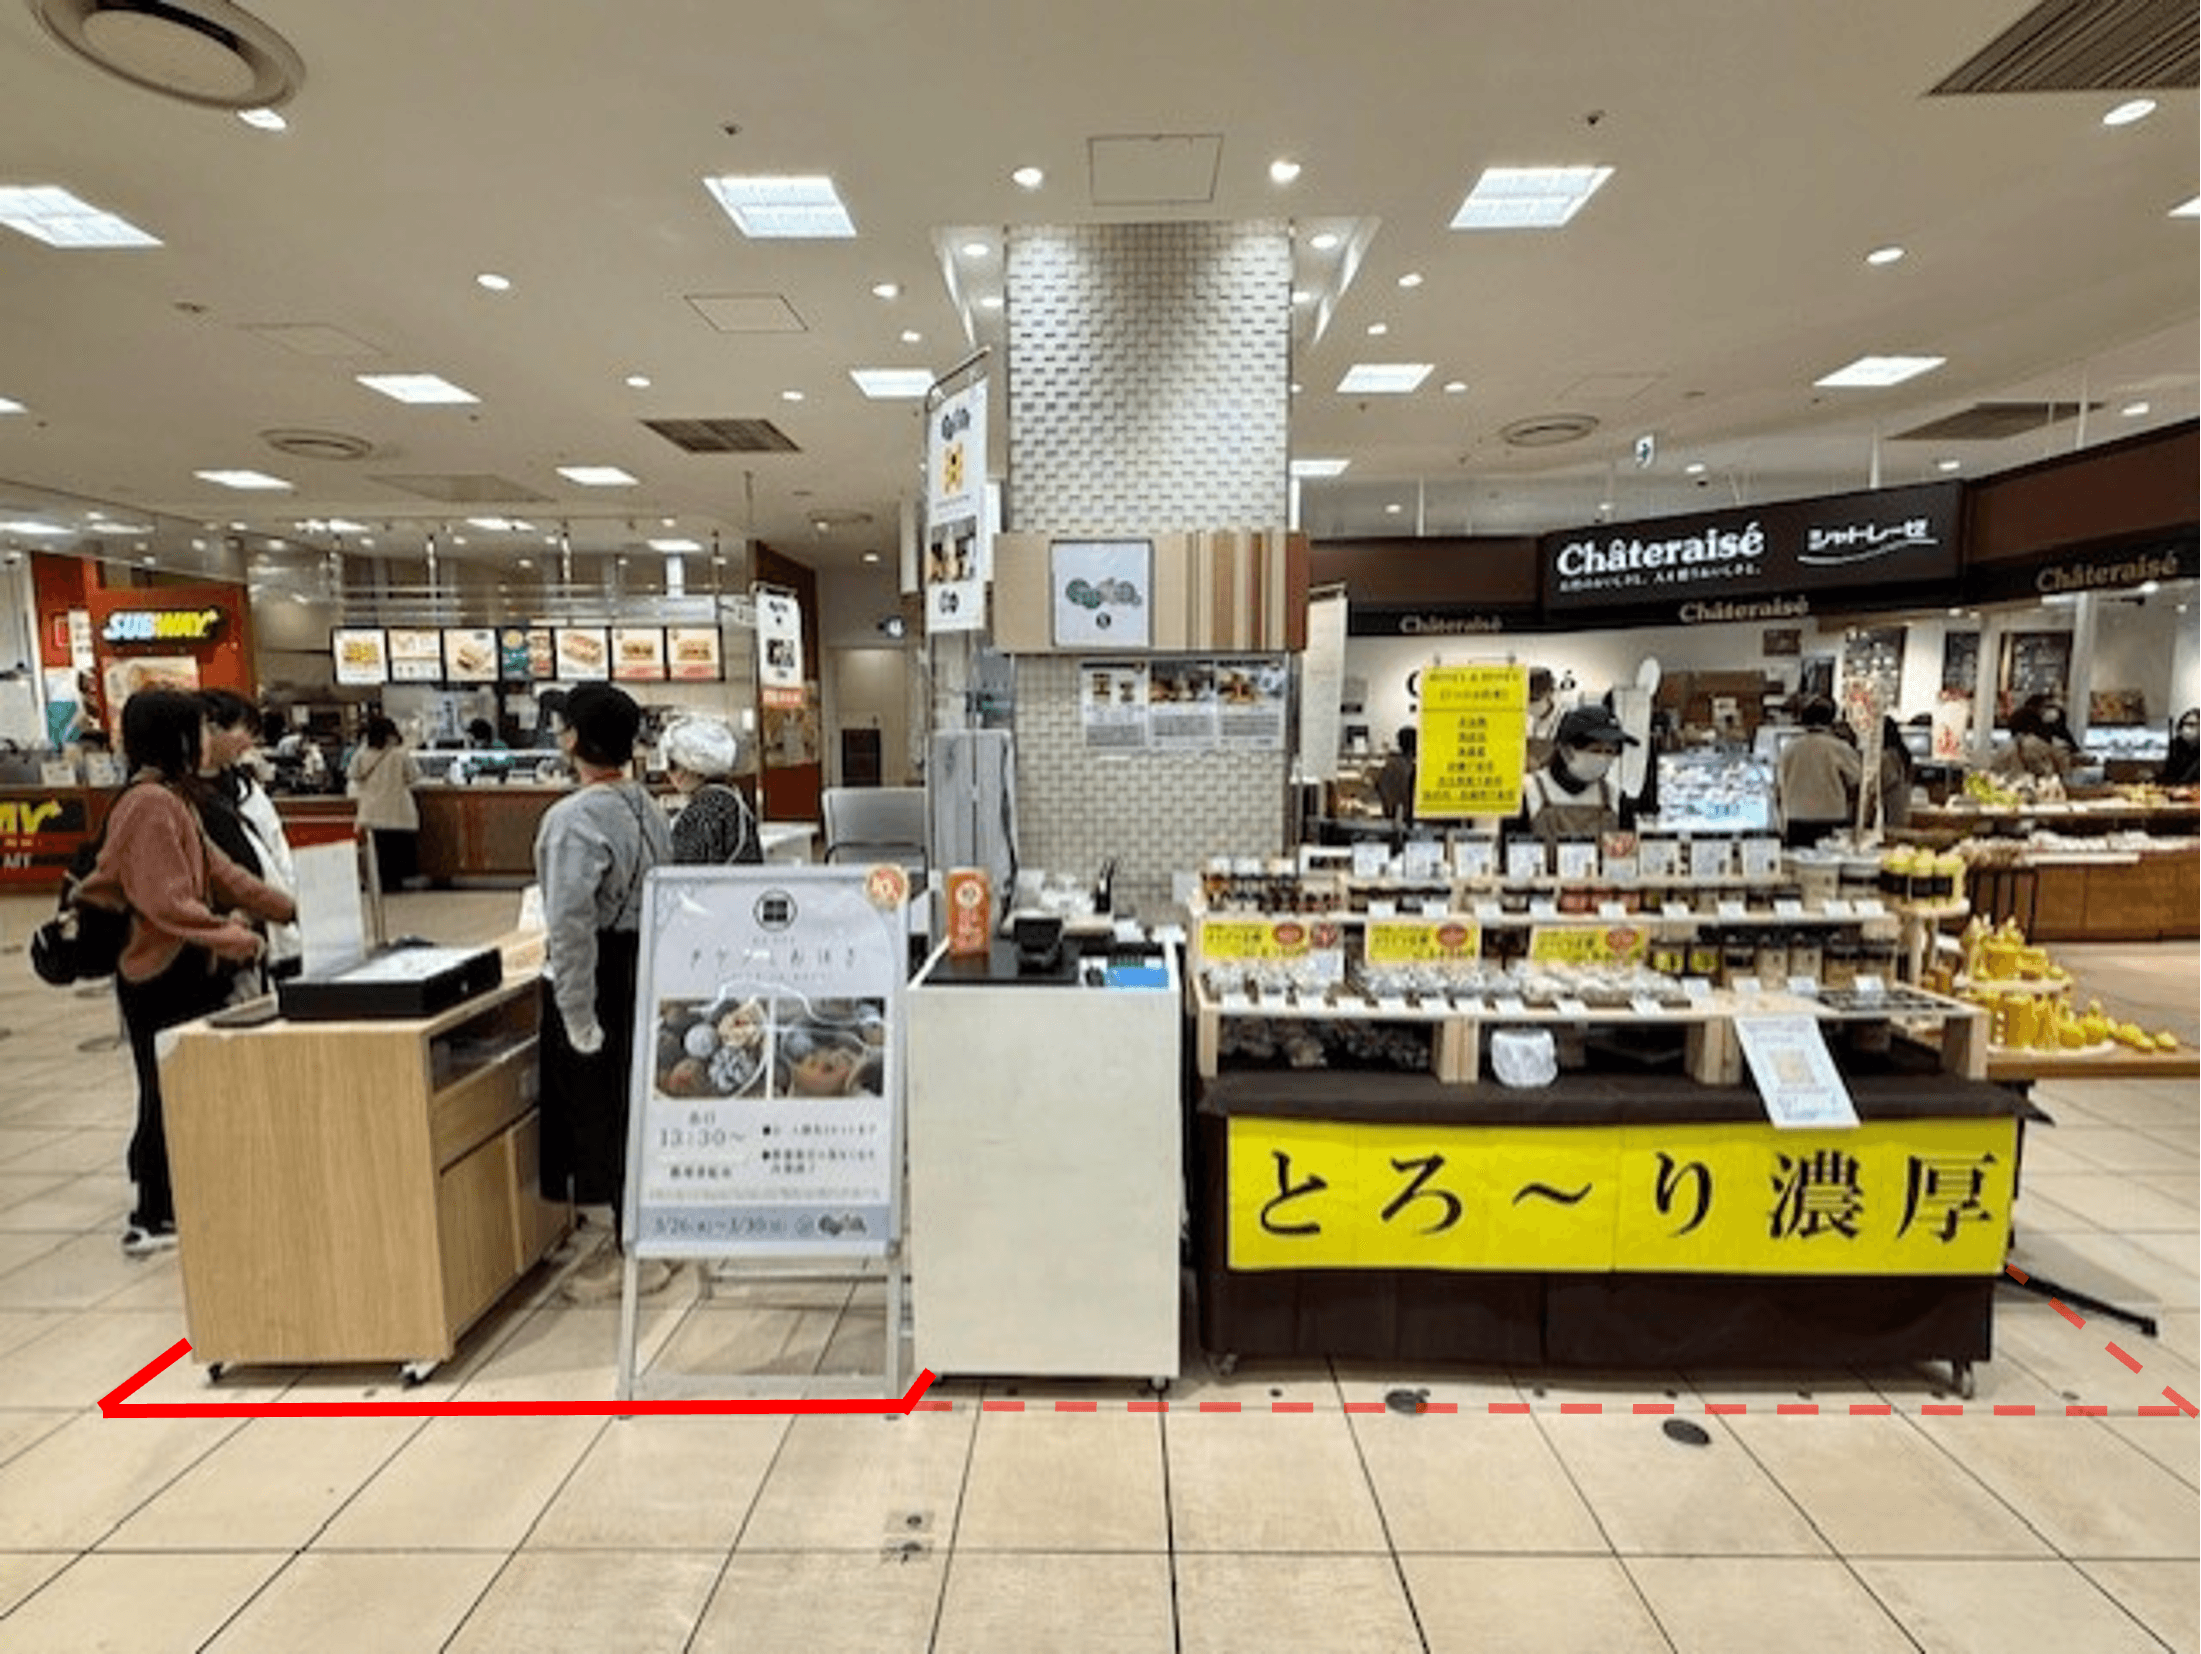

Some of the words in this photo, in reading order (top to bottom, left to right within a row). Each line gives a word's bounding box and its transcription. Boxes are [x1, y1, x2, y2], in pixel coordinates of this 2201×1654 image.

[1557, 520, 1766, 577] Châteraisé
[1807, 518, 1929, 552] シャトレーゼ
[2035, 549, 2179, 592] Châteraisé
[102, 608, 220, 641] SUBWAY
[1677, 595, 1810, 624] Châteraisé
